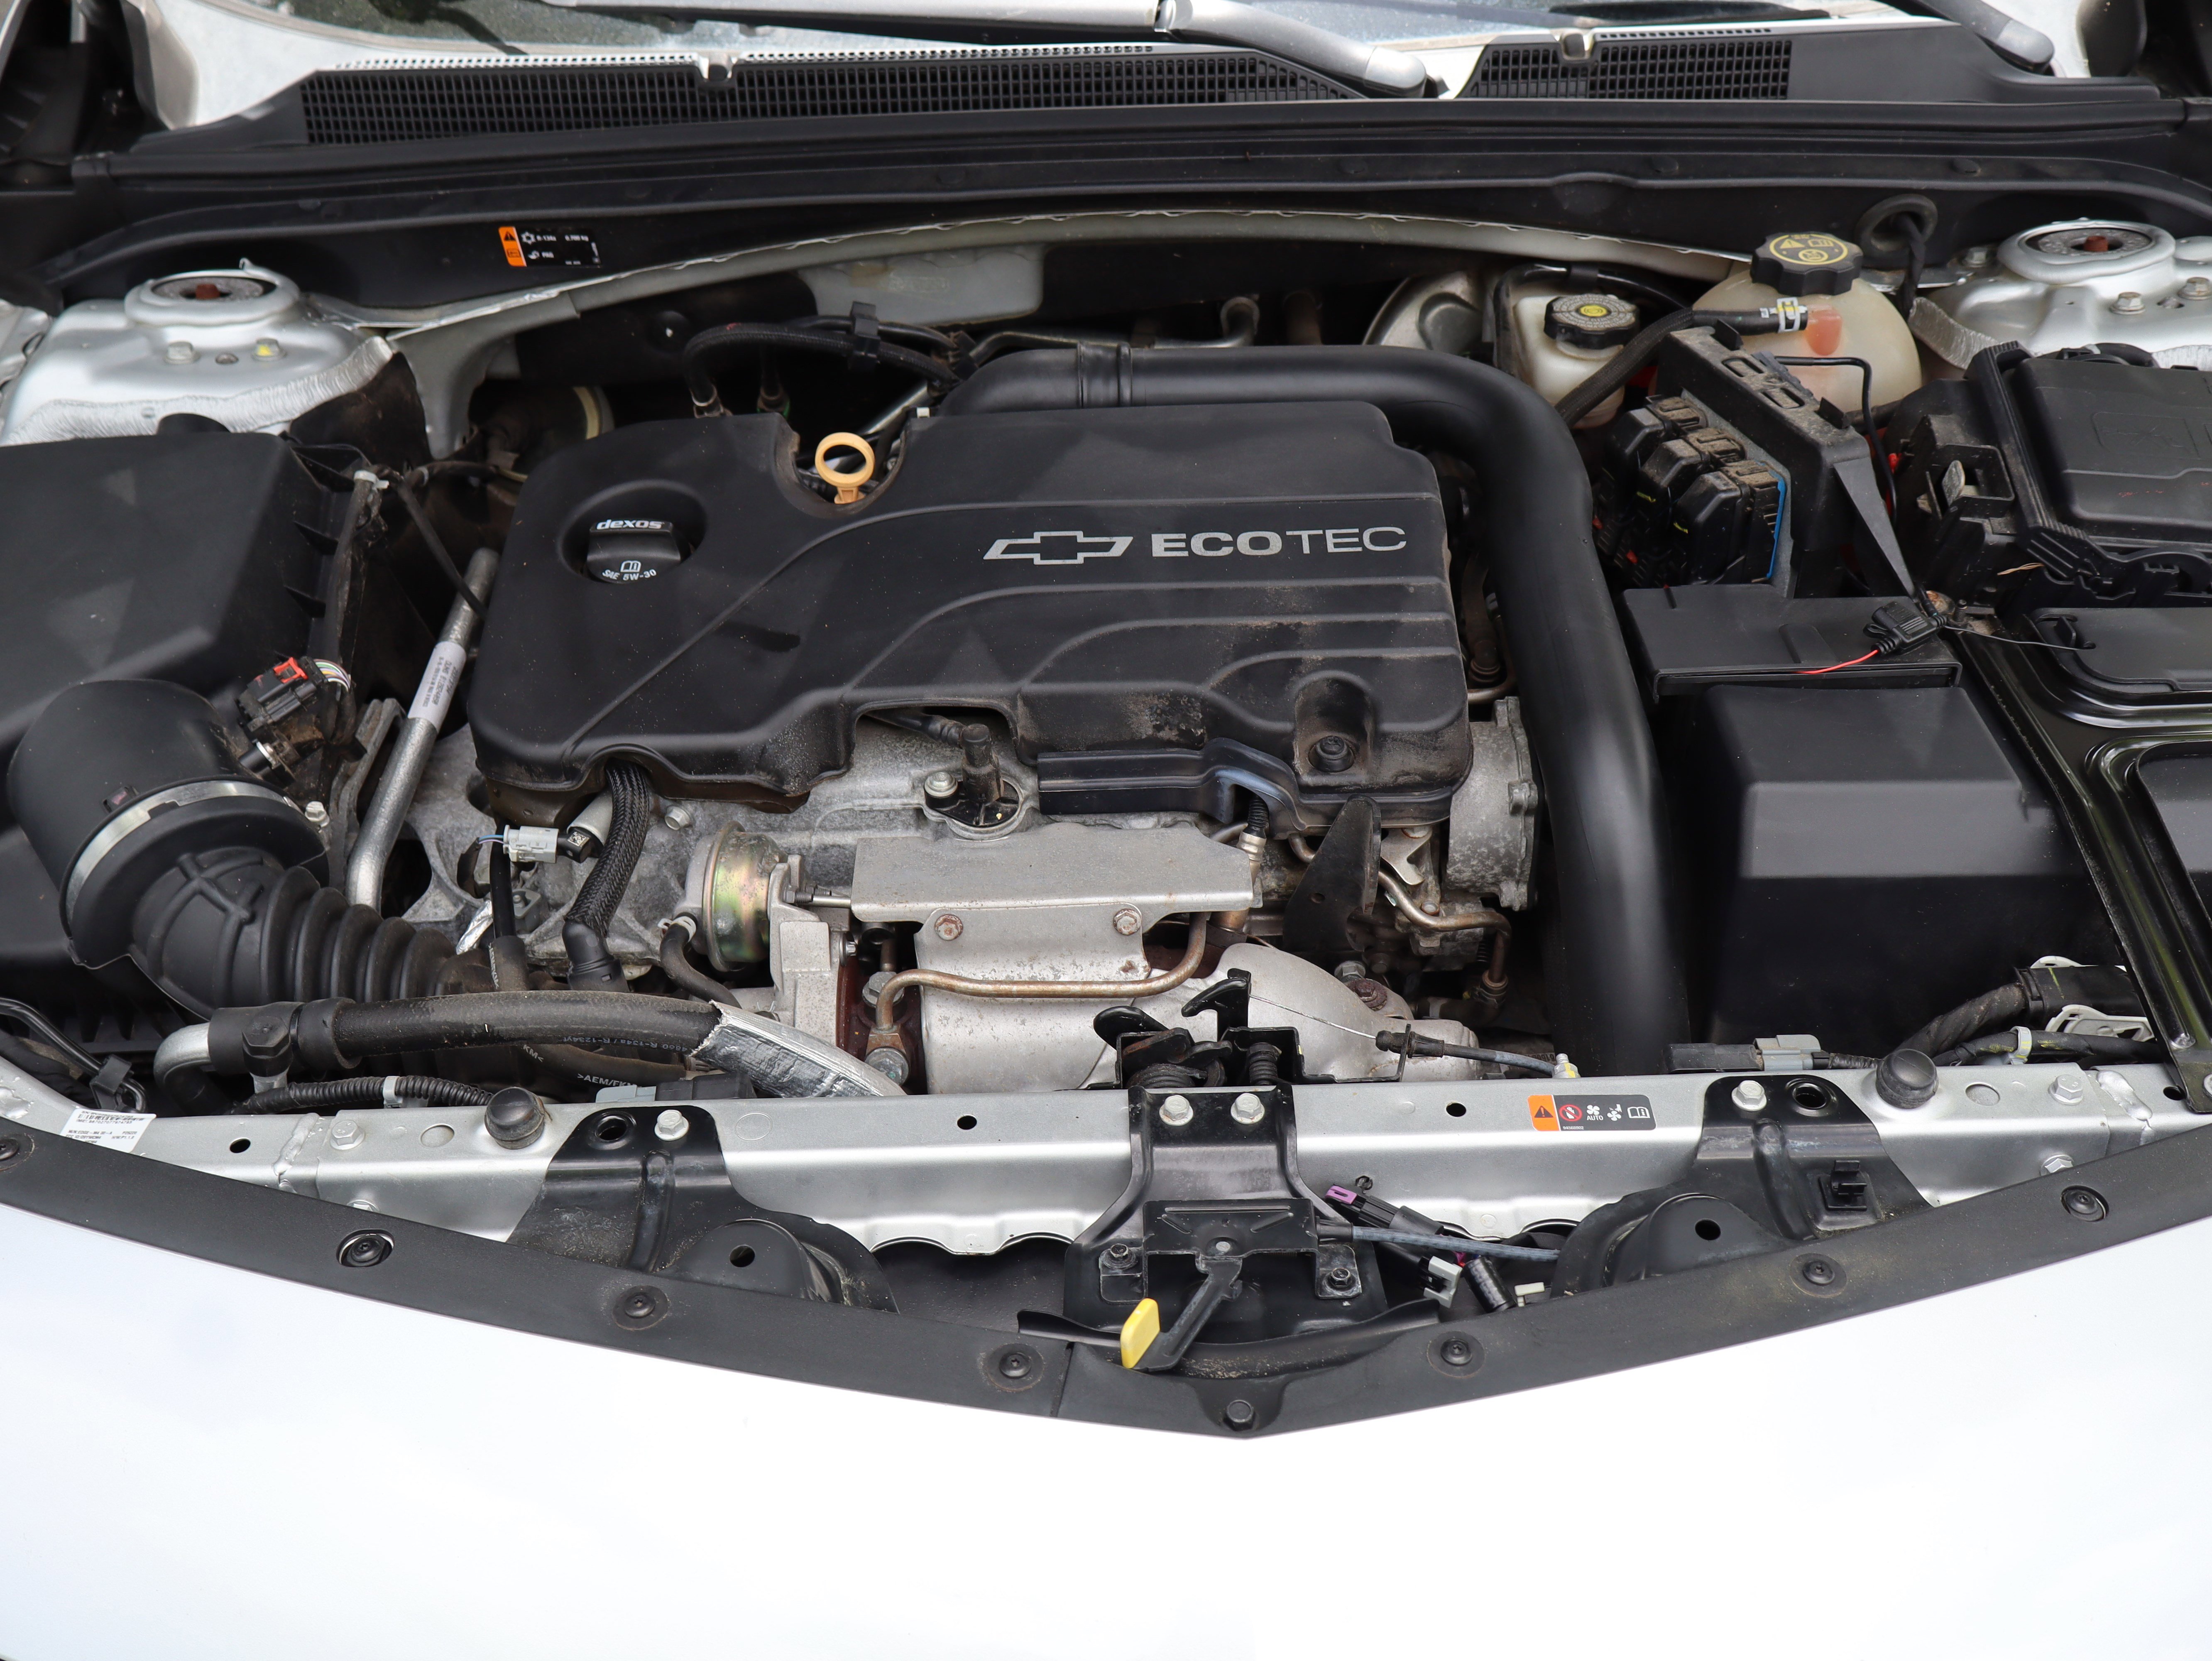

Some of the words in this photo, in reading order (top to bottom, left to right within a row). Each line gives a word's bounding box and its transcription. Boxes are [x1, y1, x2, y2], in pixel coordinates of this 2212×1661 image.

[597, 519, 661, 529] dexos
[1151, 527, 1407, 556] ECOTEC
[602, 569, 620, 580] SAE
[623, 569, 656, 581] 5W-30
[621, 1039, 658, 1048] R-134a
